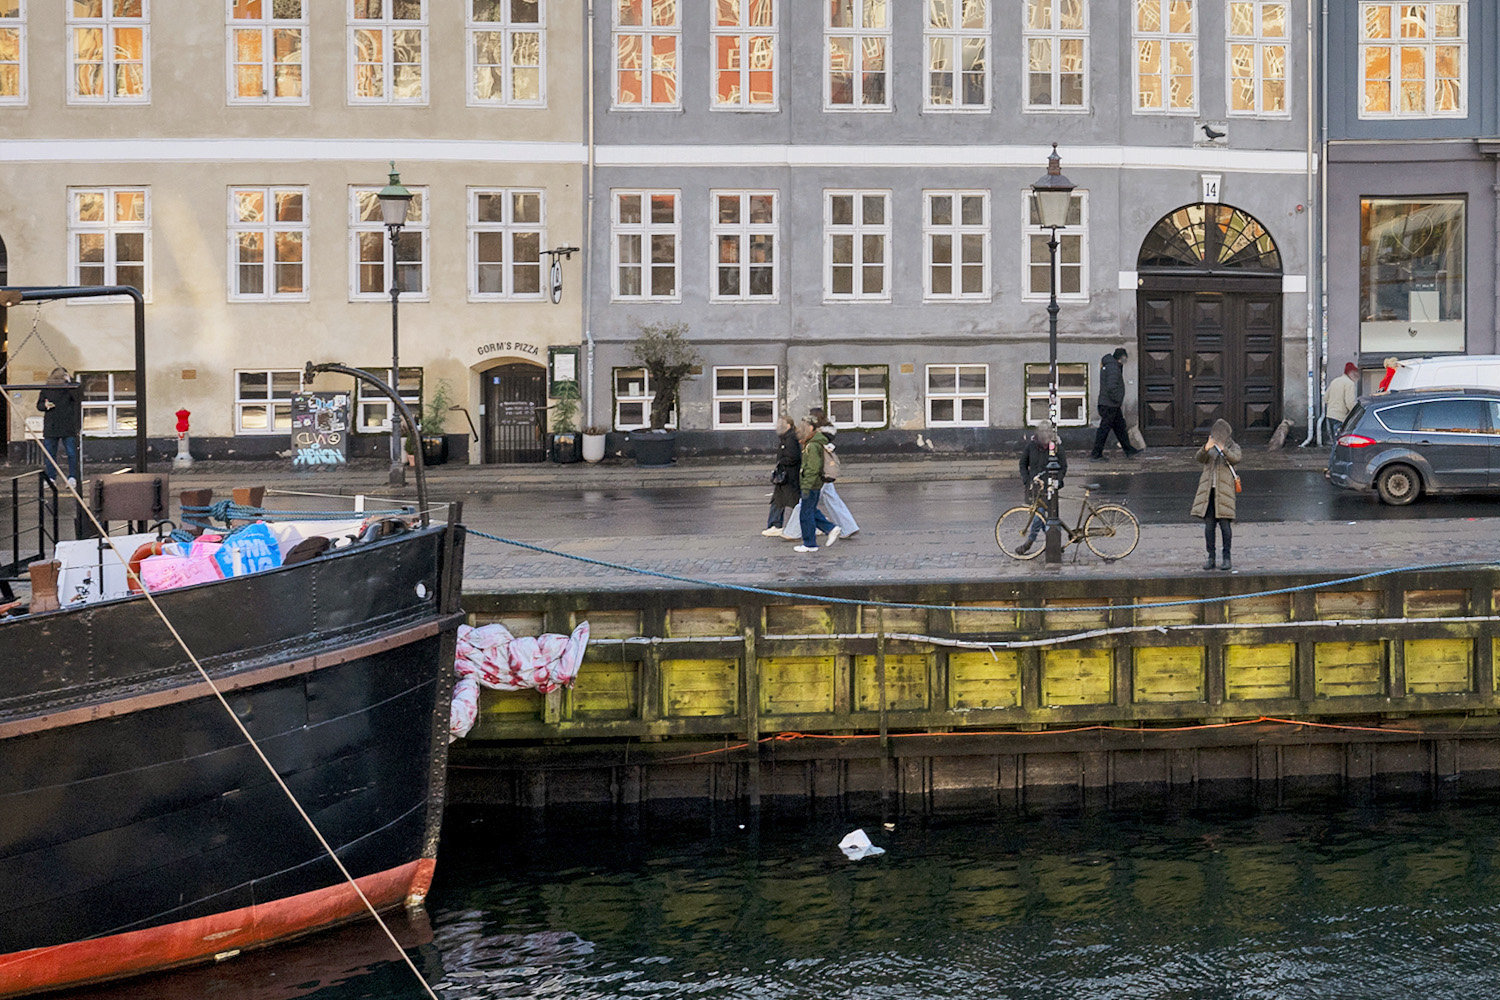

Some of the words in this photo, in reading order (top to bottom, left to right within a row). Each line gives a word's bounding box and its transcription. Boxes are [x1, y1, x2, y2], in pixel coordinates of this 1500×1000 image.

[1206, 182, 1216, 197] 14
[477, 341, 512, 356] GORM'S
[514, 342, 539, 356] PIZZA
